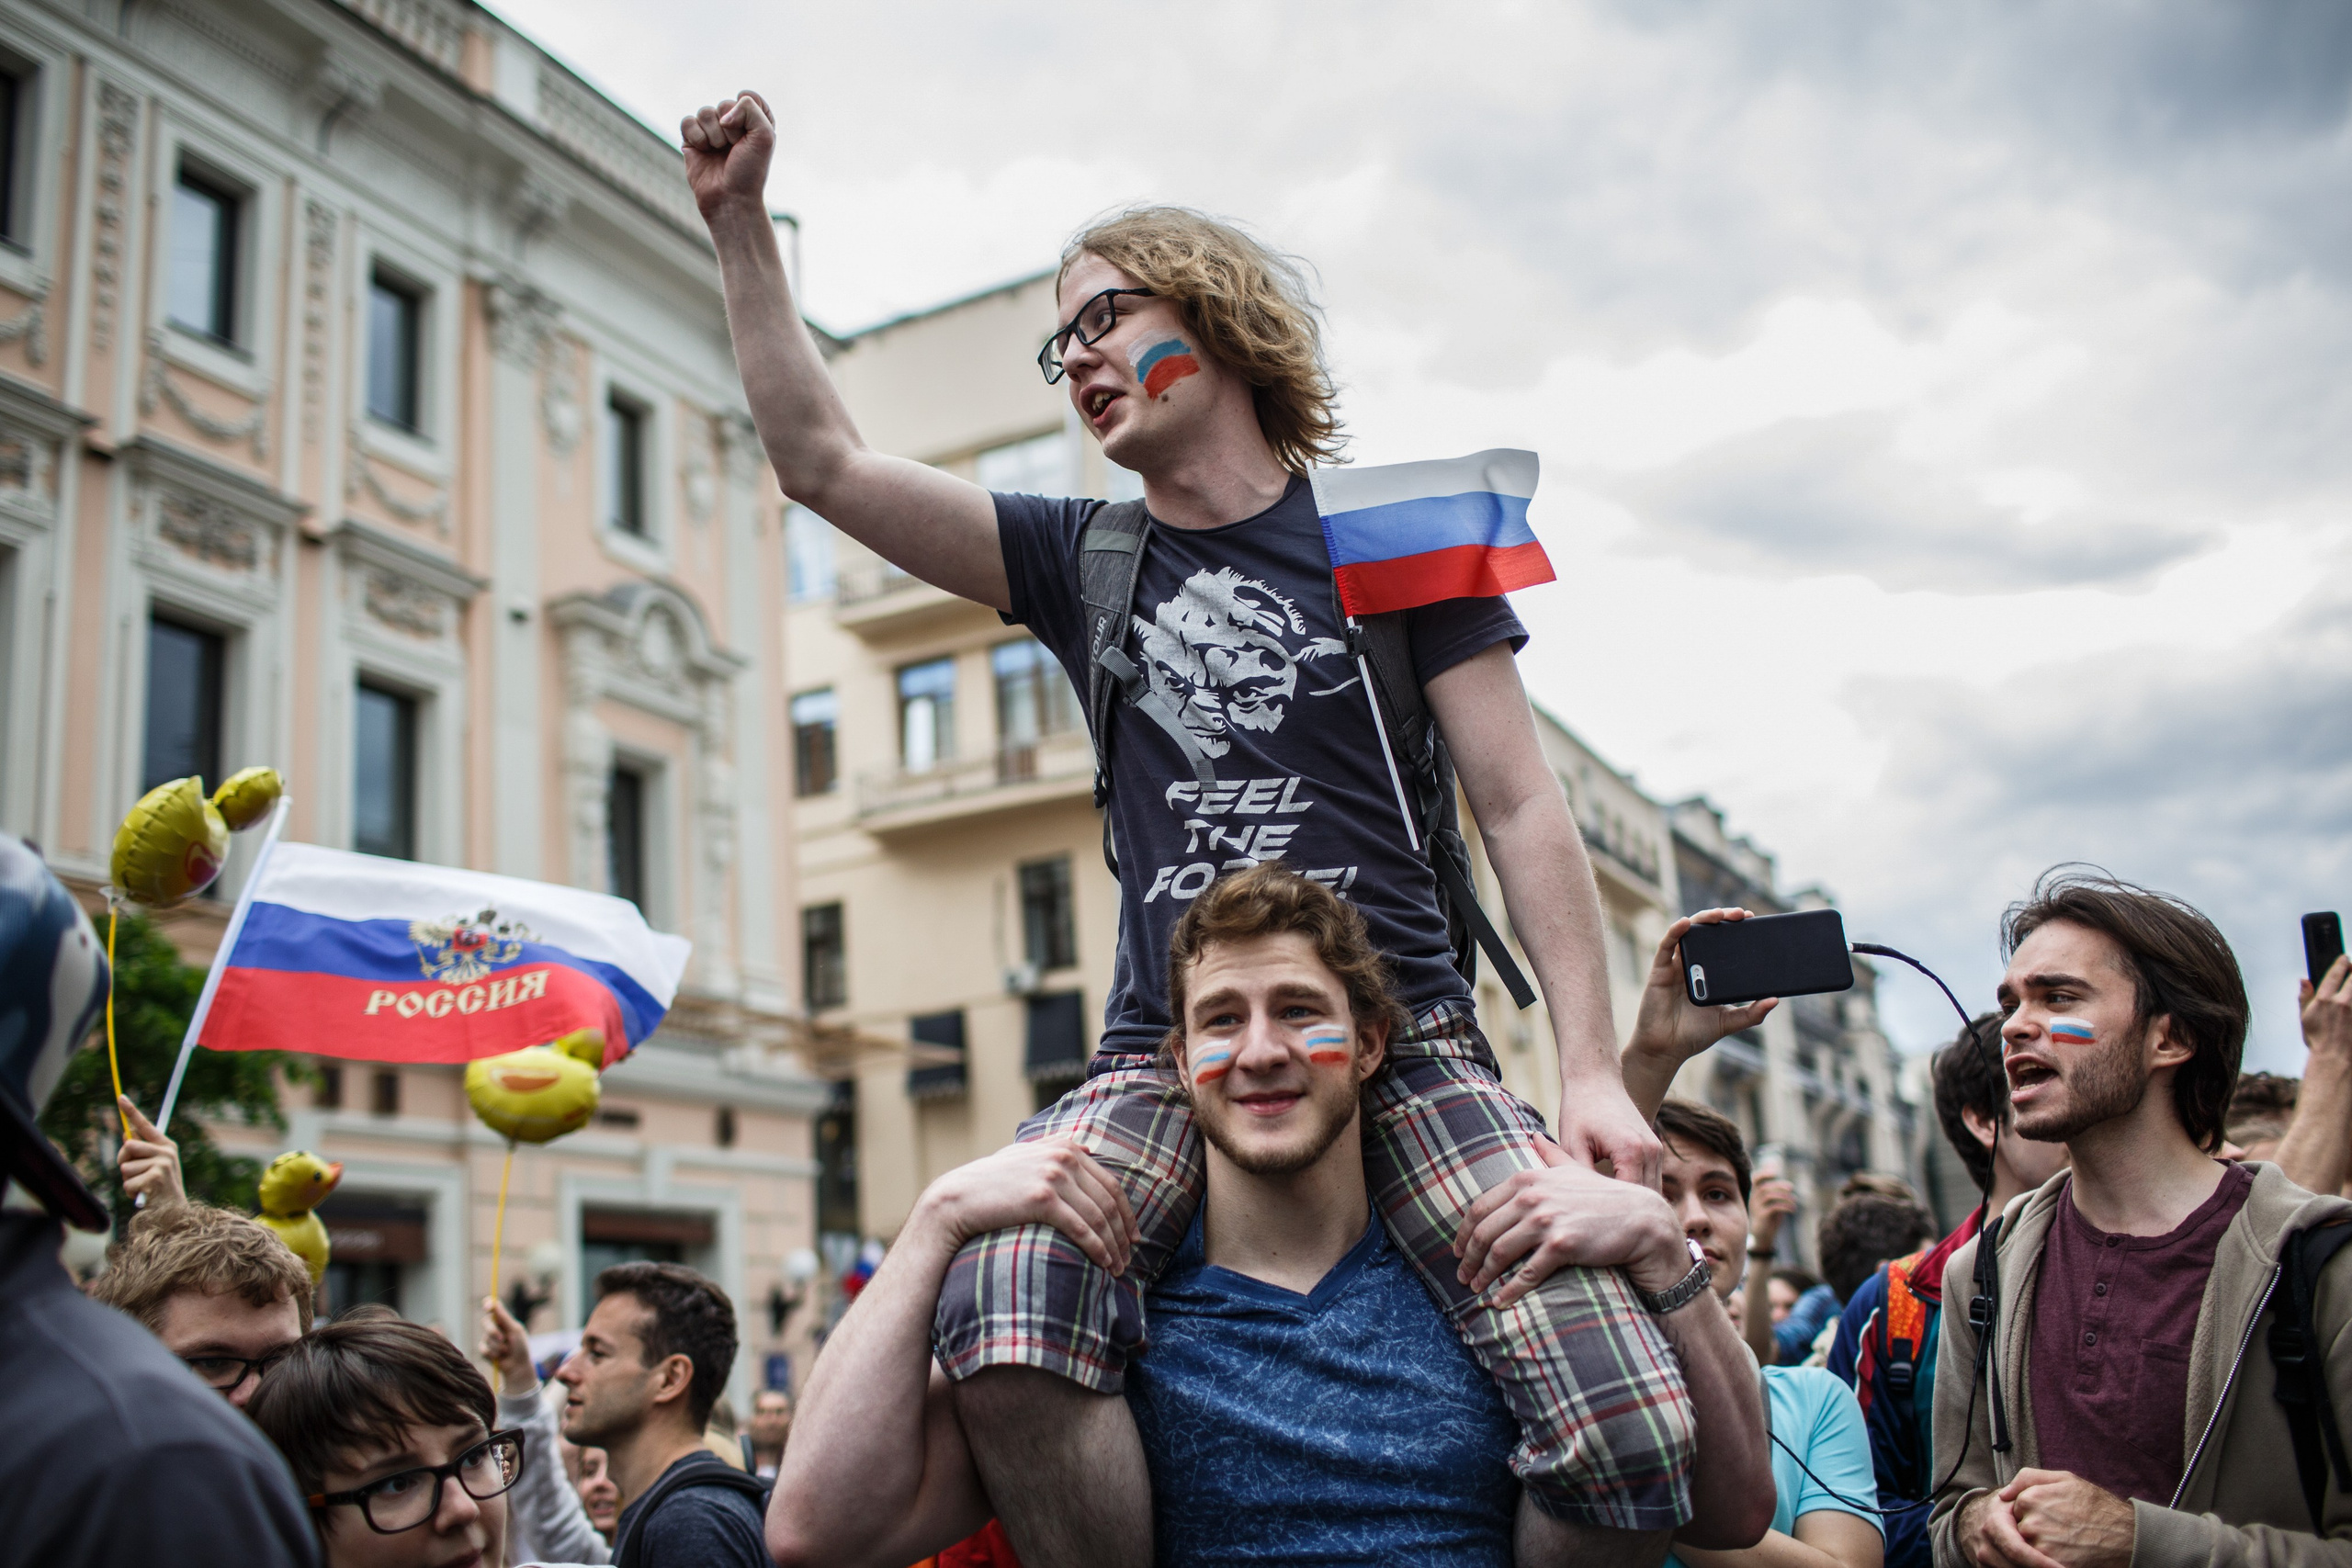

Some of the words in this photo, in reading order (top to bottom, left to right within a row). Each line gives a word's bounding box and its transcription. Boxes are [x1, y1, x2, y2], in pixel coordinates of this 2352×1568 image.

[1091, 615, 1106, 663] TOUR
[1165, 776, 1314, 815] FEEL
[1184, 818, 1300, 861] THE
[1144, 857, 1358, 903] FOE!
[363, 969, 550, 1019] РОССИЯ
